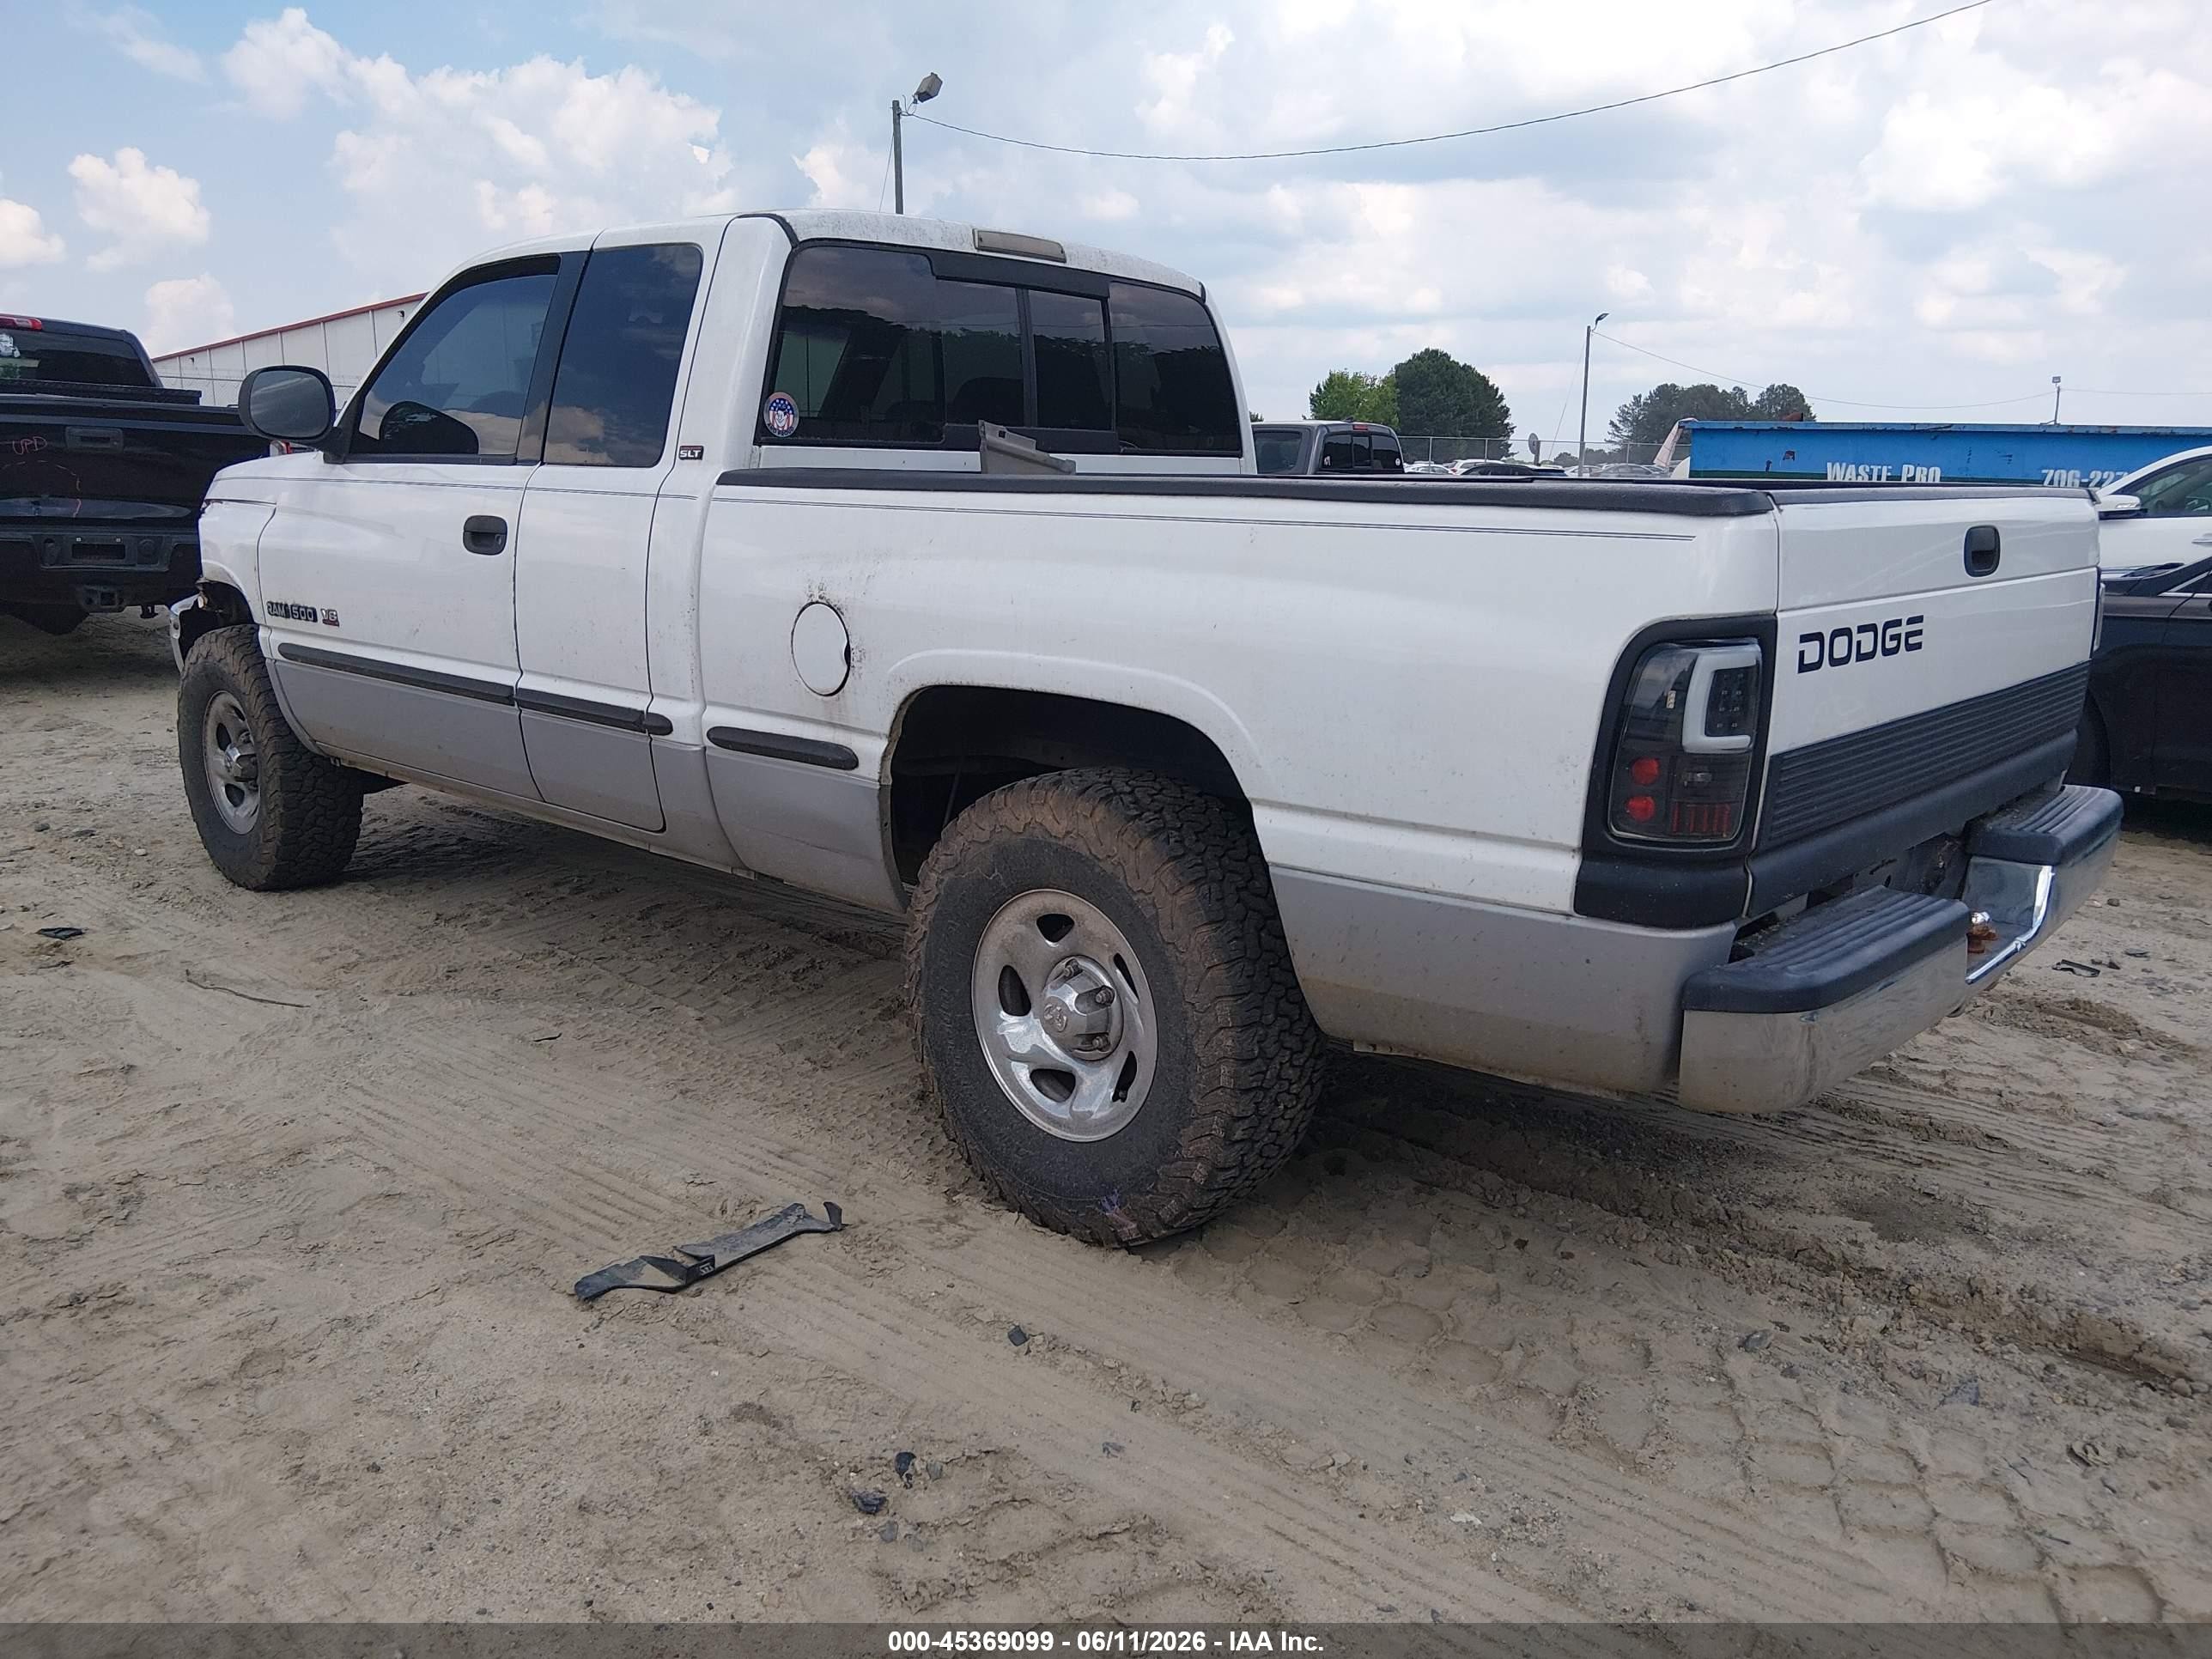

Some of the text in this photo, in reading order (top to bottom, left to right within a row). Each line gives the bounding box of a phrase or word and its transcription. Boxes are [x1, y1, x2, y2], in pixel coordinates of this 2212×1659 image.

[1826, 462, 1941, 483] WASTE PRO
[266, 602, 287, 617] RAM
[1797, 615, 1923, 674] DODGE
